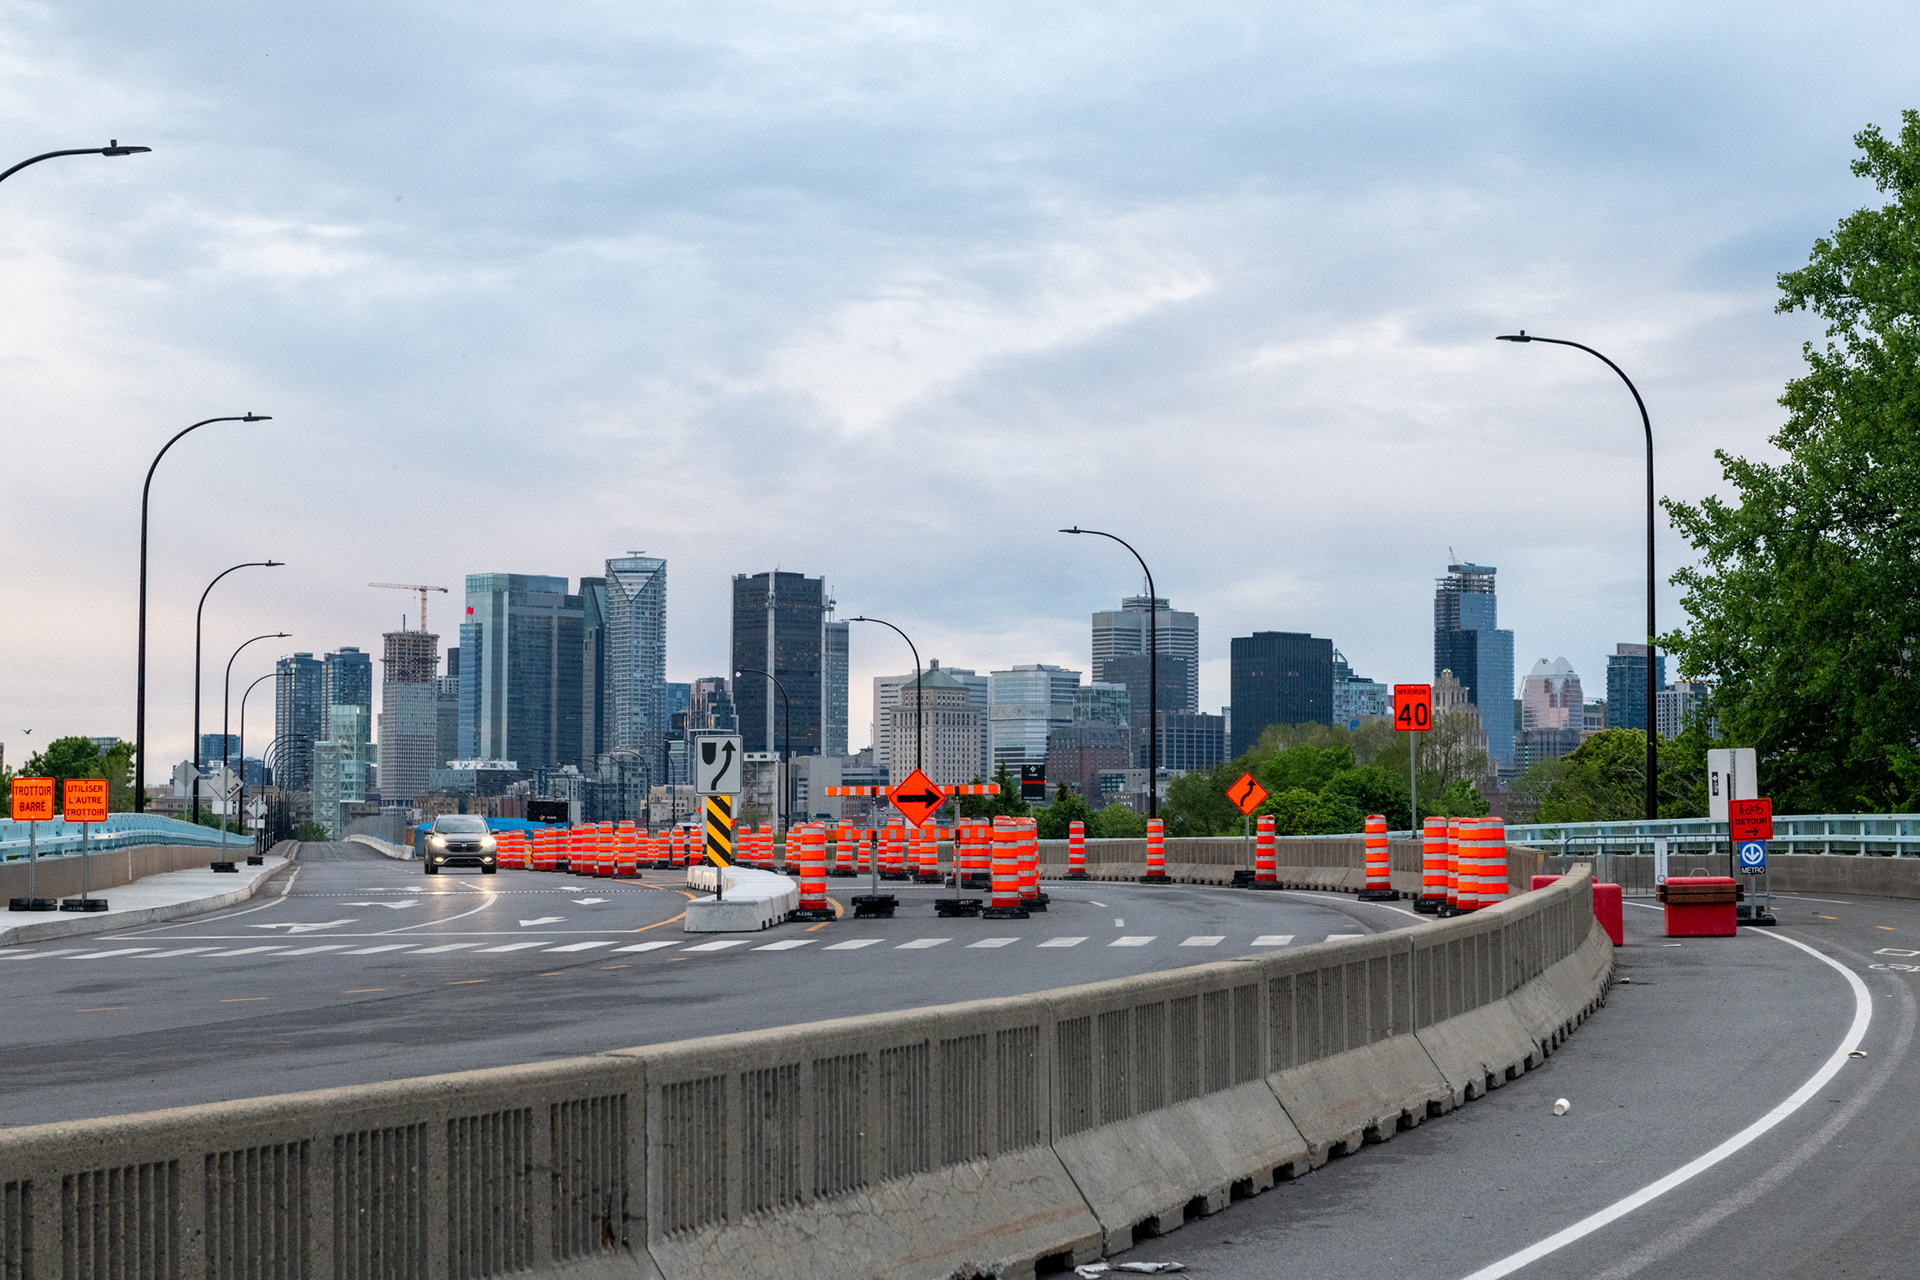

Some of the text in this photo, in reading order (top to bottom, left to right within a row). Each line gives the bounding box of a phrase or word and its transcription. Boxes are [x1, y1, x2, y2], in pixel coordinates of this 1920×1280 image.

[1398, 703, 1427, 726] 40
[15, 786, 52, 796] TROTTOIR
[20, 800, 46, 811] BARRÉ
[1741, 866, 1764, 874] METRO
